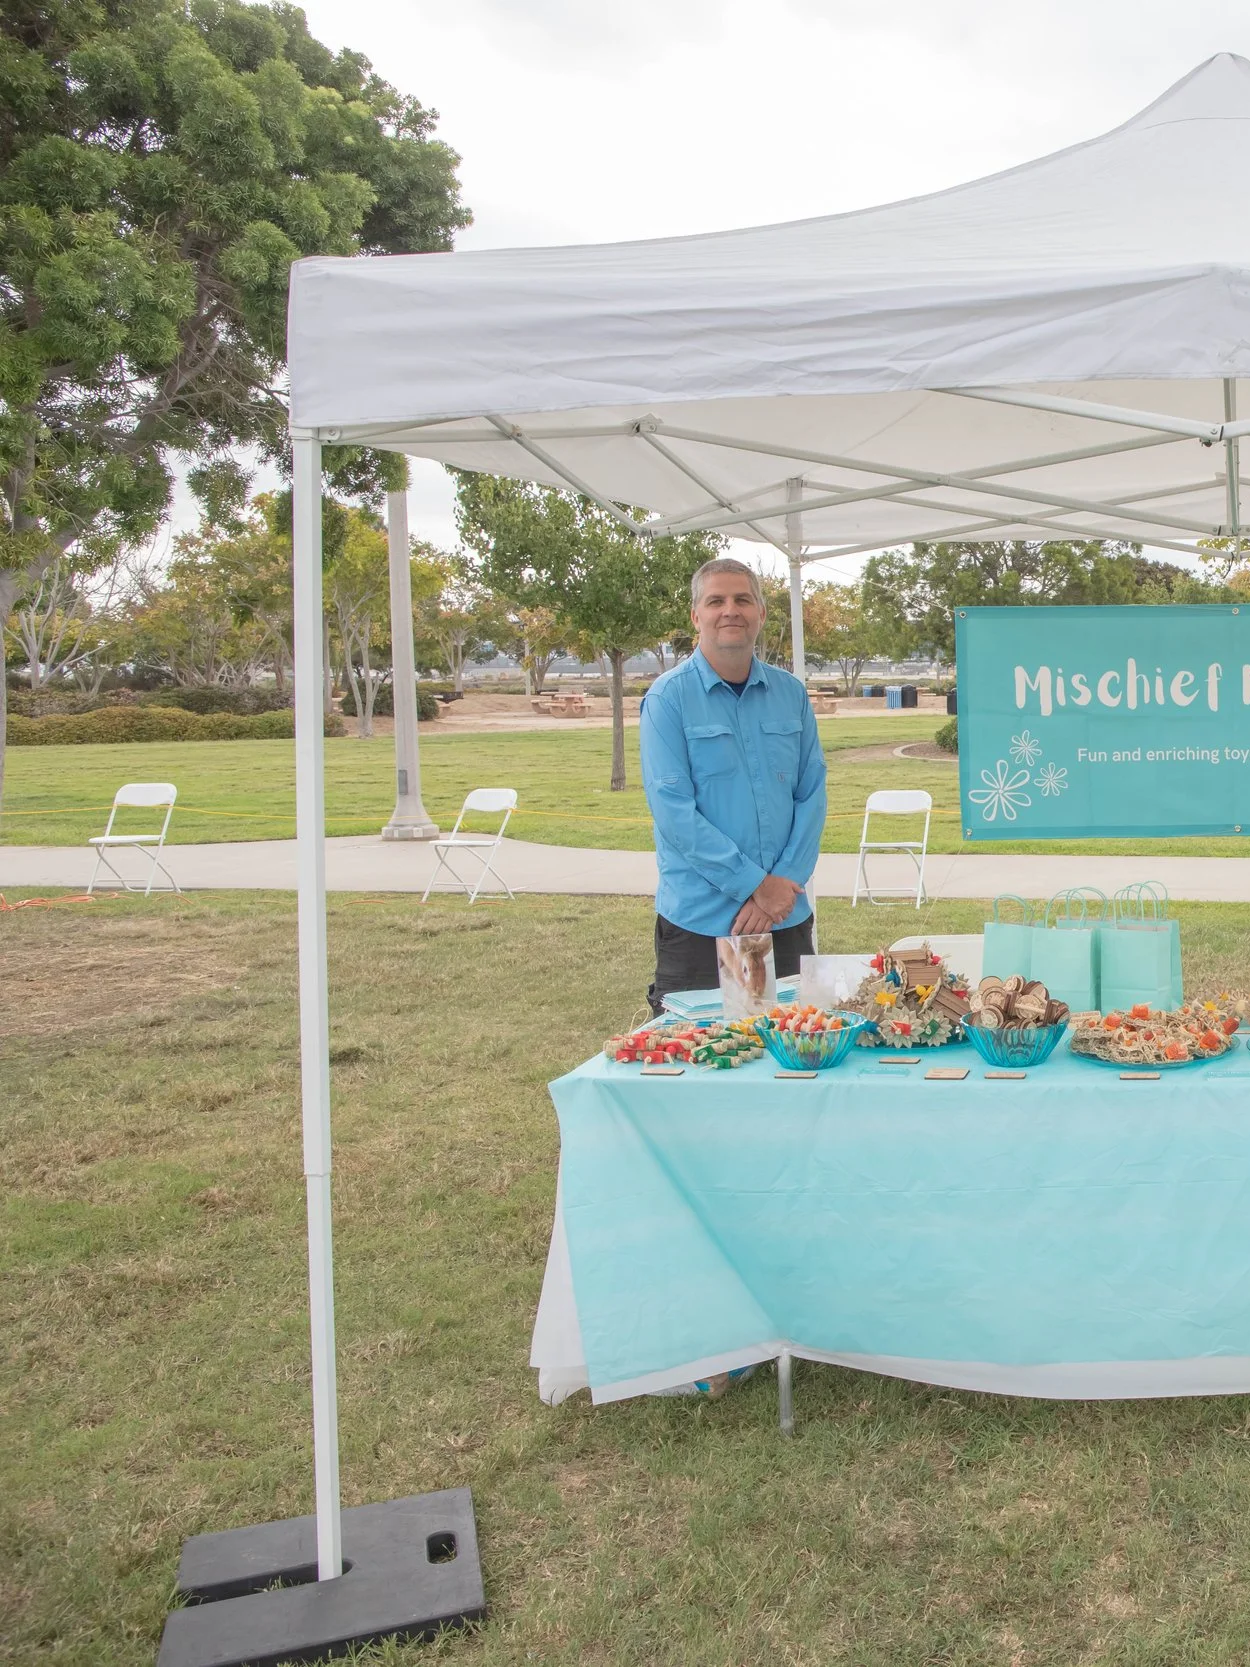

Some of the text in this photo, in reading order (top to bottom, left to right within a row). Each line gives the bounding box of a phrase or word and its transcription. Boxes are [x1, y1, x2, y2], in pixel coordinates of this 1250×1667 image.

[1014, 657, 1223, 717] Mischief
[1077, 747, 1108, 762] Fun
[1112, 747, 1141, 762] and
[1145, 746, 1220, 765] enriching
